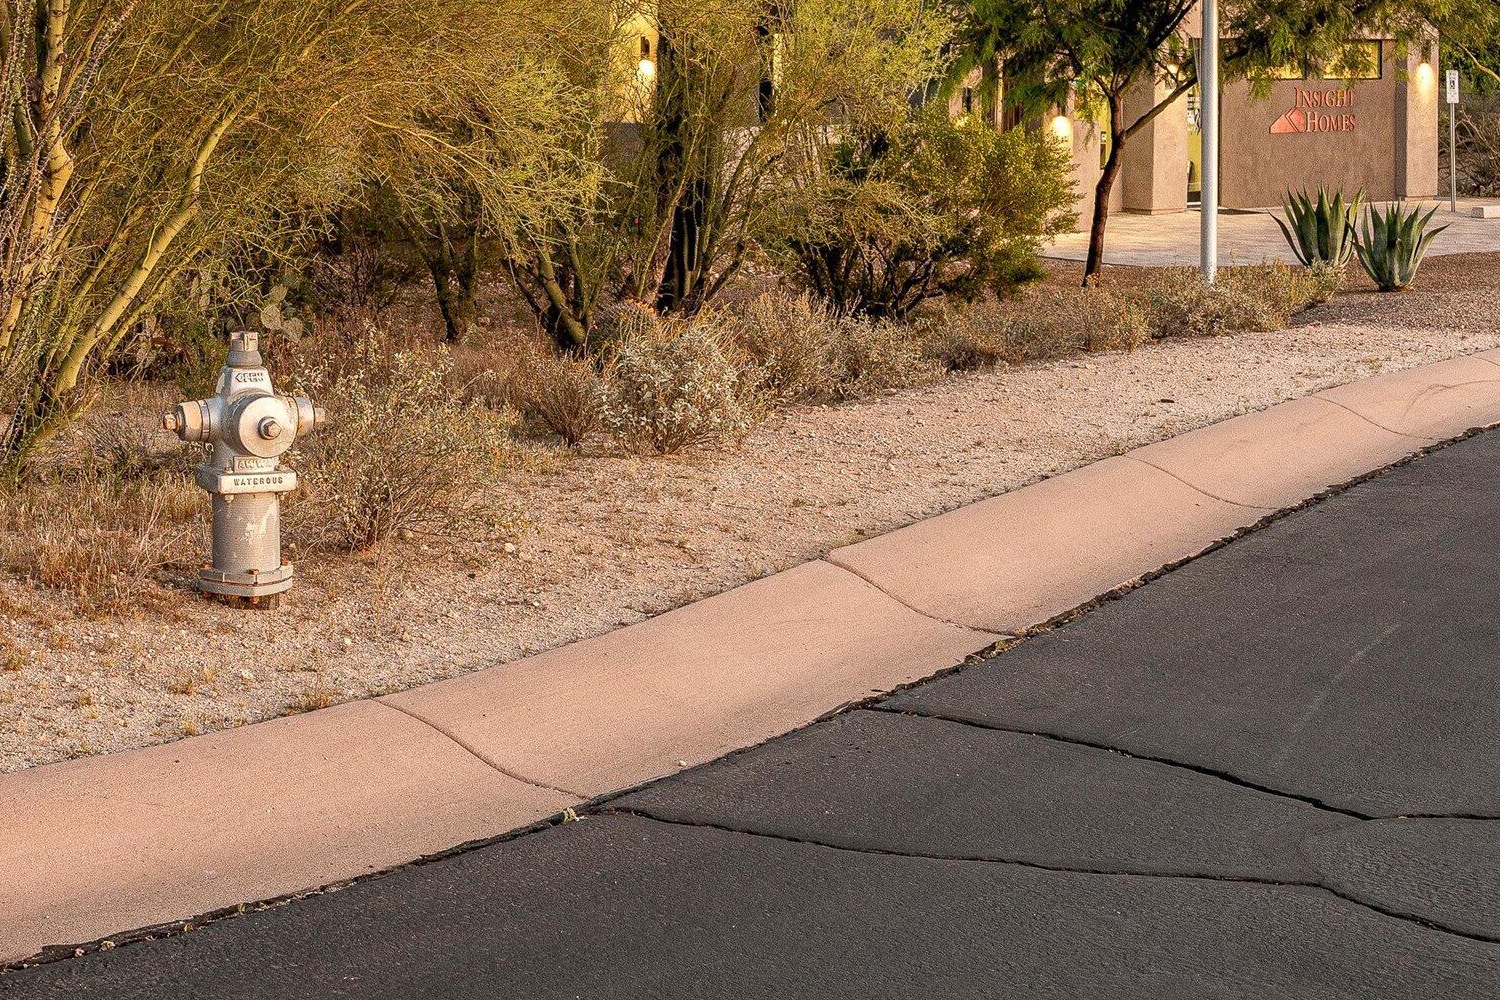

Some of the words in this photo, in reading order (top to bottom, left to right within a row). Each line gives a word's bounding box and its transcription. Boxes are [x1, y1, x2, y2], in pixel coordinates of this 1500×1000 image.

[1294, 87, 1355, 108] INSIGHT
[1304, 111, 1356, 133] HOMES
[233, 476, 283, 487] WATEROUS
